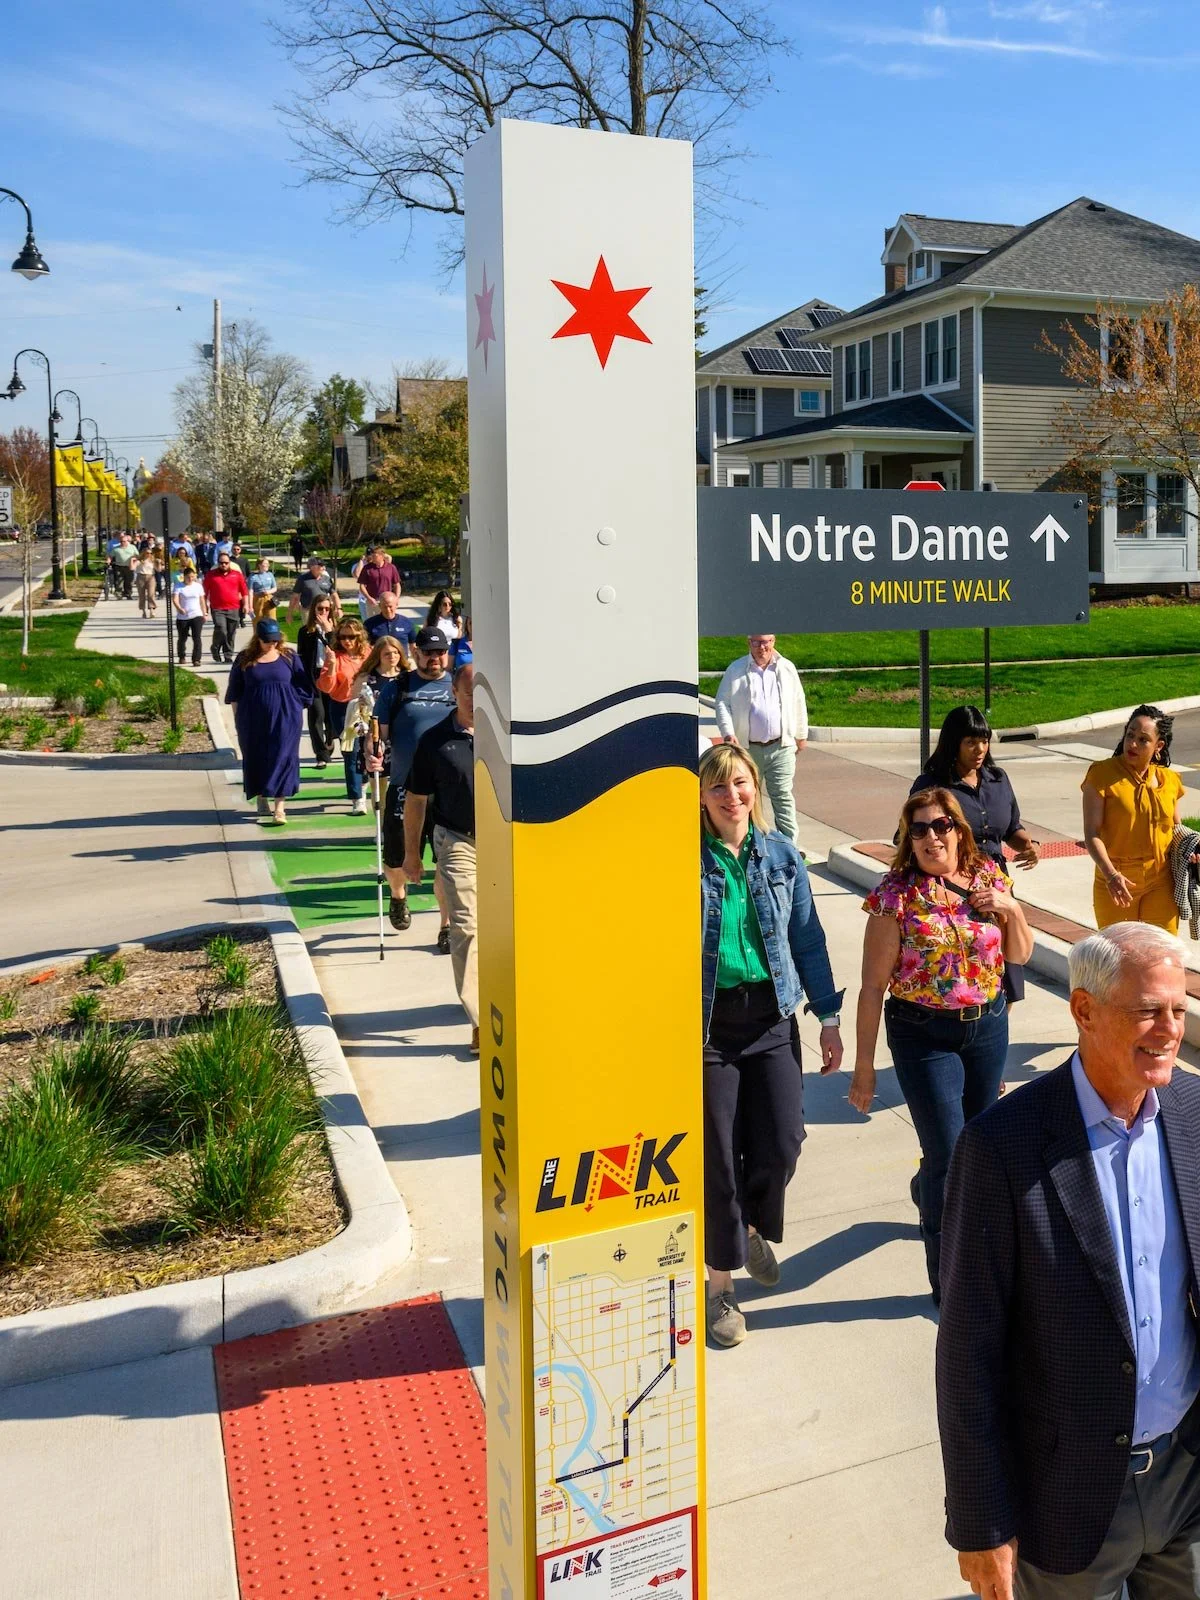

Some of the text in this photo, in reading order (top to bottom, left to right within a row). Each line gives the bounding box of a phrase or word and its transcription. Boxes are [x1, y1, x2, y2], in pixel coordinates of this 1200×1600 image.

[749, 513, 1009, 563] Notre Dame
[850, 579, 1011, 605] 8 MINUTE WALK
[535, 1131, 688, 1213] LINK
[542, 1158, 558, 1187] THE
[634, 1187, 681, 1210] TRAIL
[490, 1002, 512, 1439] DOWNTOWN
[499, 1460, 513, 1546] TO
[550, 1548, 605, 1583] LINK
[585, 1568, 602, 1578] TRAIL
